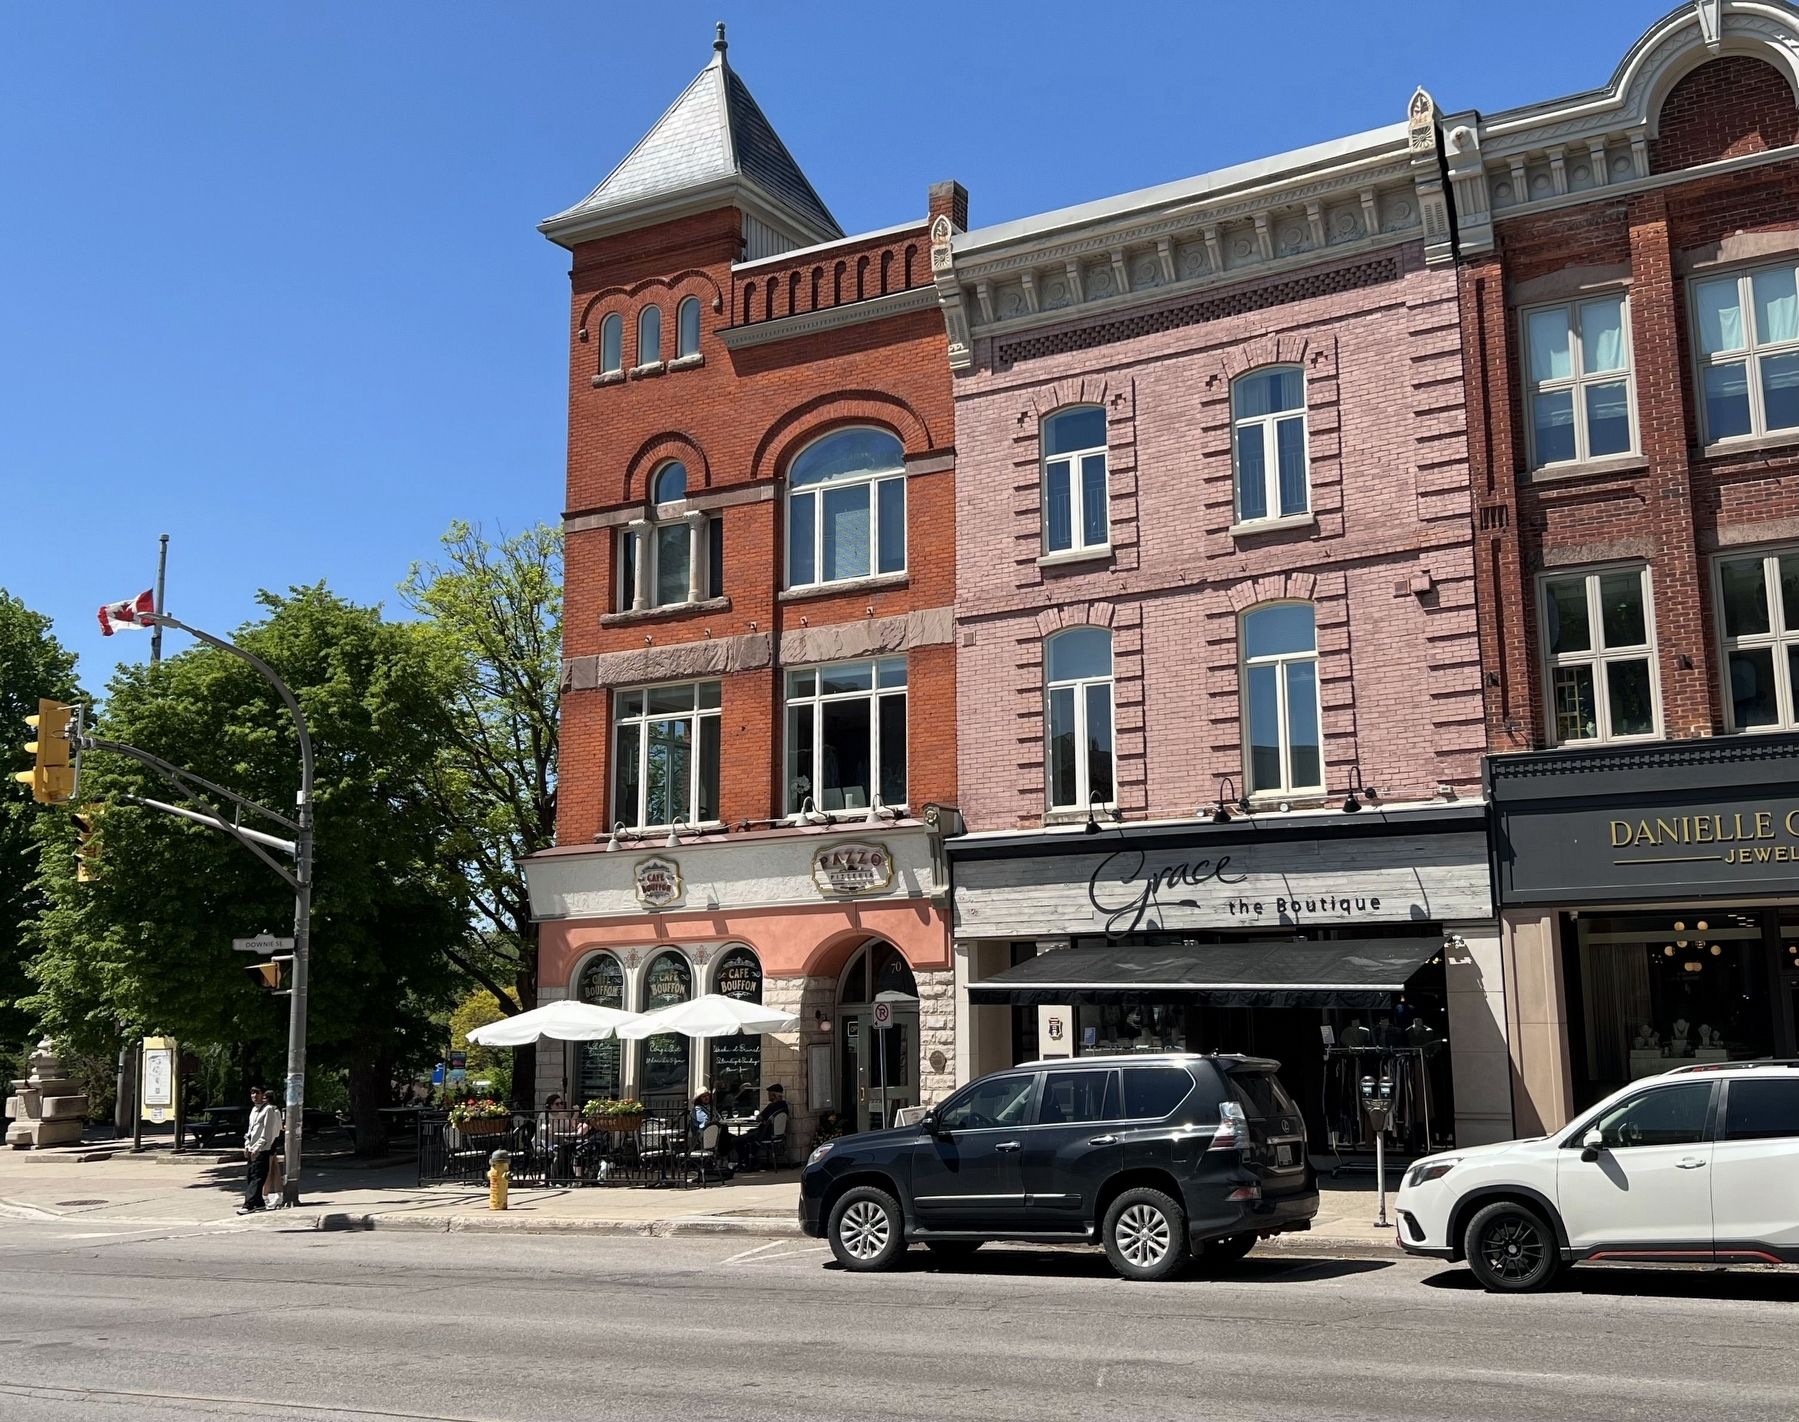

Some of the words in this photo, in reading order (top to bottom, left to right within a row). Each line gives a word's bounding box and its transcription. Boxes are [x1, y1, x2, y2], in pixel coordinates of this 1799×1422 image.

[1610, 812, 1776, 848] DANIELLE
[819, 850, 882, 869] PAZZO
[641, 884, 672, 893] BOUFFON
[1089, 850, 1247, 940] Grace
[1229, 899, 1264, 916] the
[1277, 896, 1381, 916] Boutique
[728, 968, 750, 979] CAFE
[891, 961, 902, 975] 70
[659, 971, 679, 982] CAFE
[584, 986, 619, 996] BOUFFON
[650, 983, 686, 995] BOUFFON
[721, 980, 757, 992] BOUFFON
